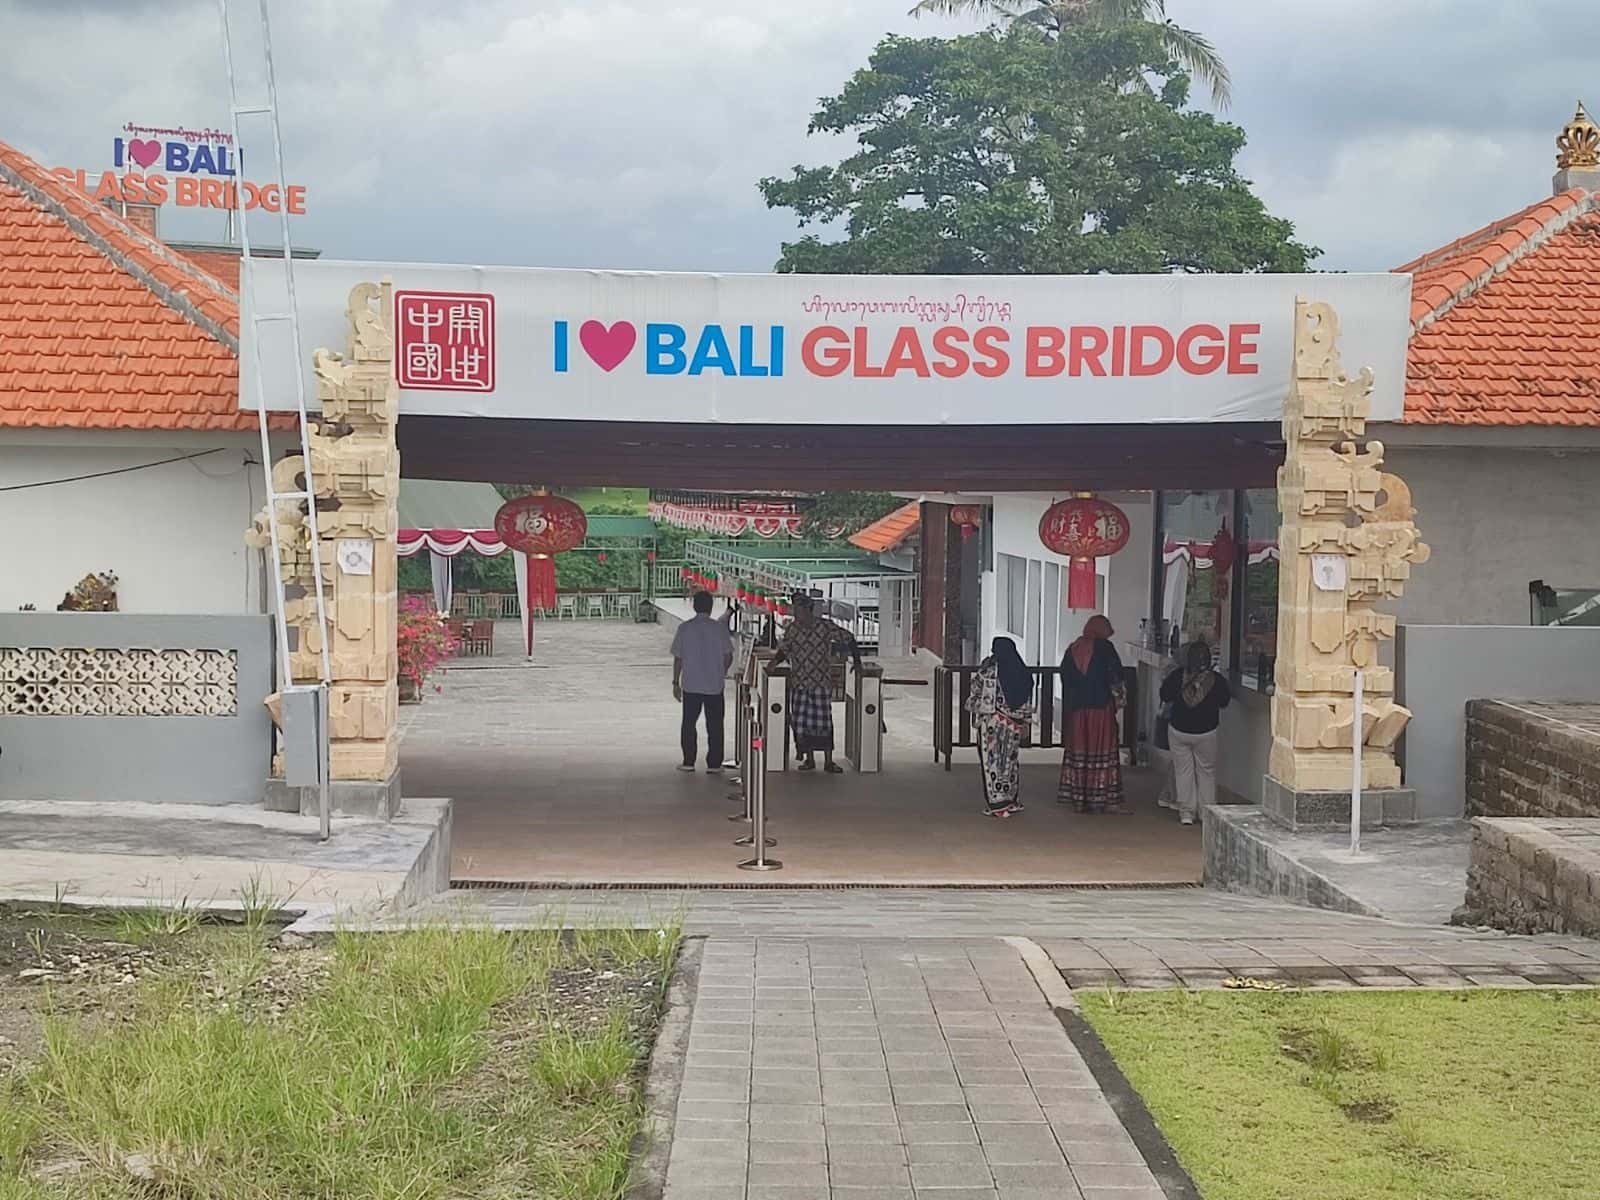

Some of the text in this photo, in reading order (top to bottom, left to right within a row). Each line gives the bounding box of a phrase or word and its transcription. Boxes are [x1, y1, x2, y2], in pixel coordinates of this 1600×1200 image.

[114, 138, 124, 167] I
[175, 176, 306, 215] BRIDGE
[554, 321, 1261, 378] I BALI GLASS BRIDGE
